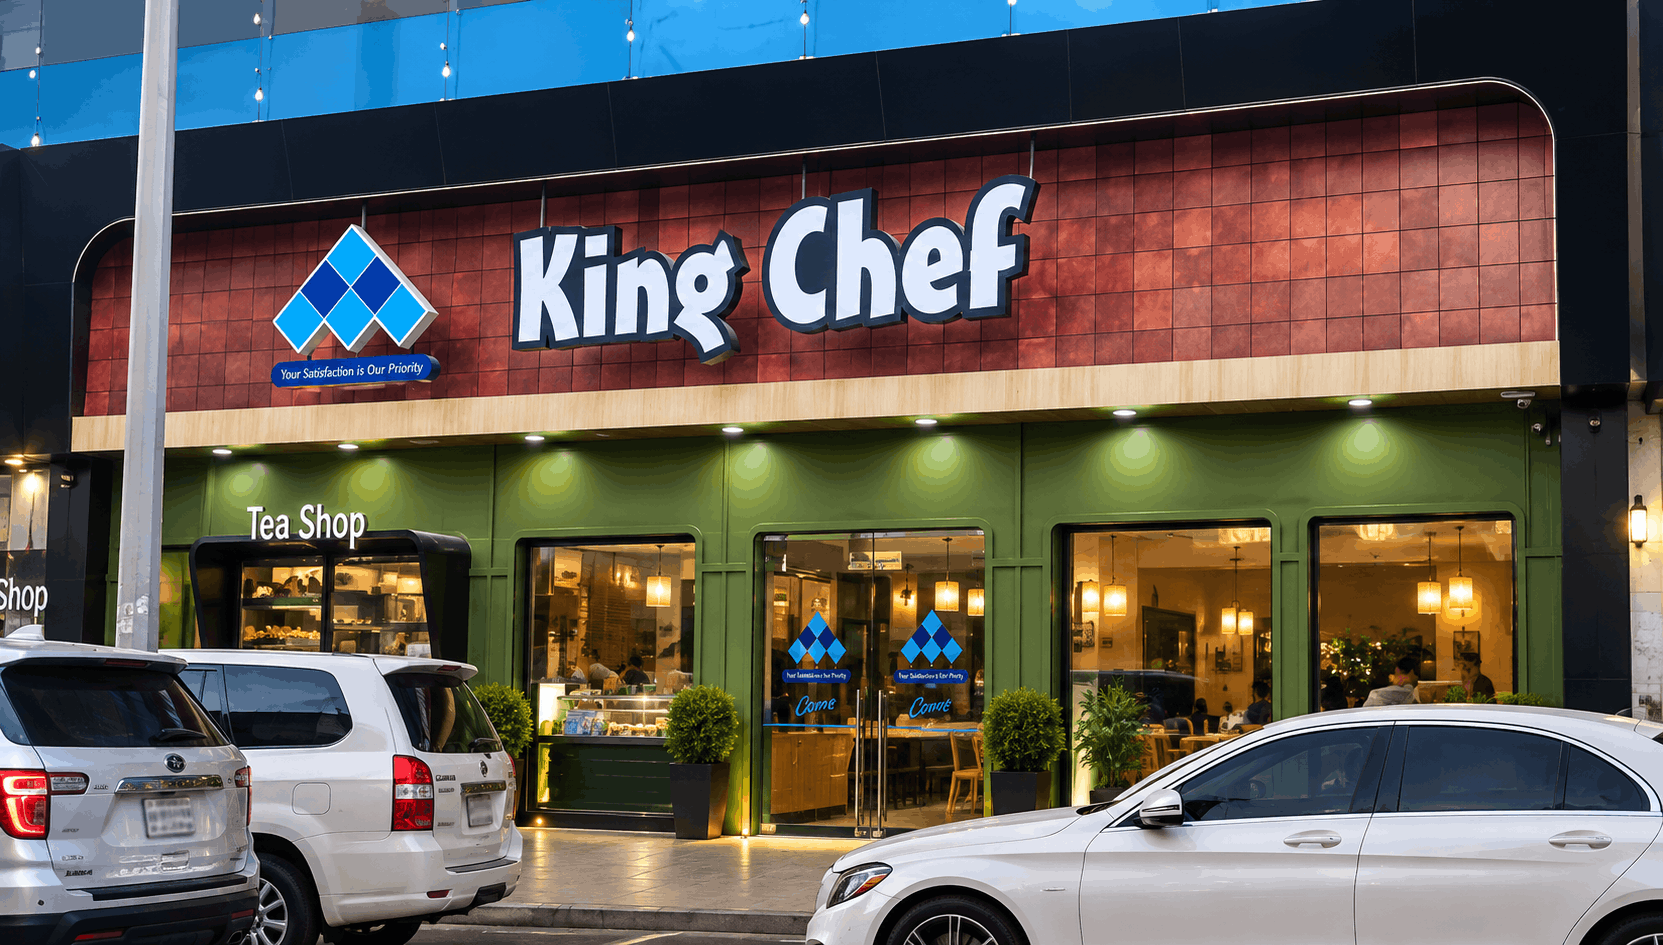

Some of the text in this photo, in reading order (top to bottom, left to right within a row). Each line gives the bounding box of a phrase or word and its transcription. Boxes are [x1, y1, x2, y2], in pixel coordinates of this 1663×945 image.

[514, 178, 1034, 360] King Chef
[280, 362, 424, 380] Your Satisfaction is Our Priority
[246, 503, 366, 549] Tea Shop
[0, 577, 49, 618] Shop
